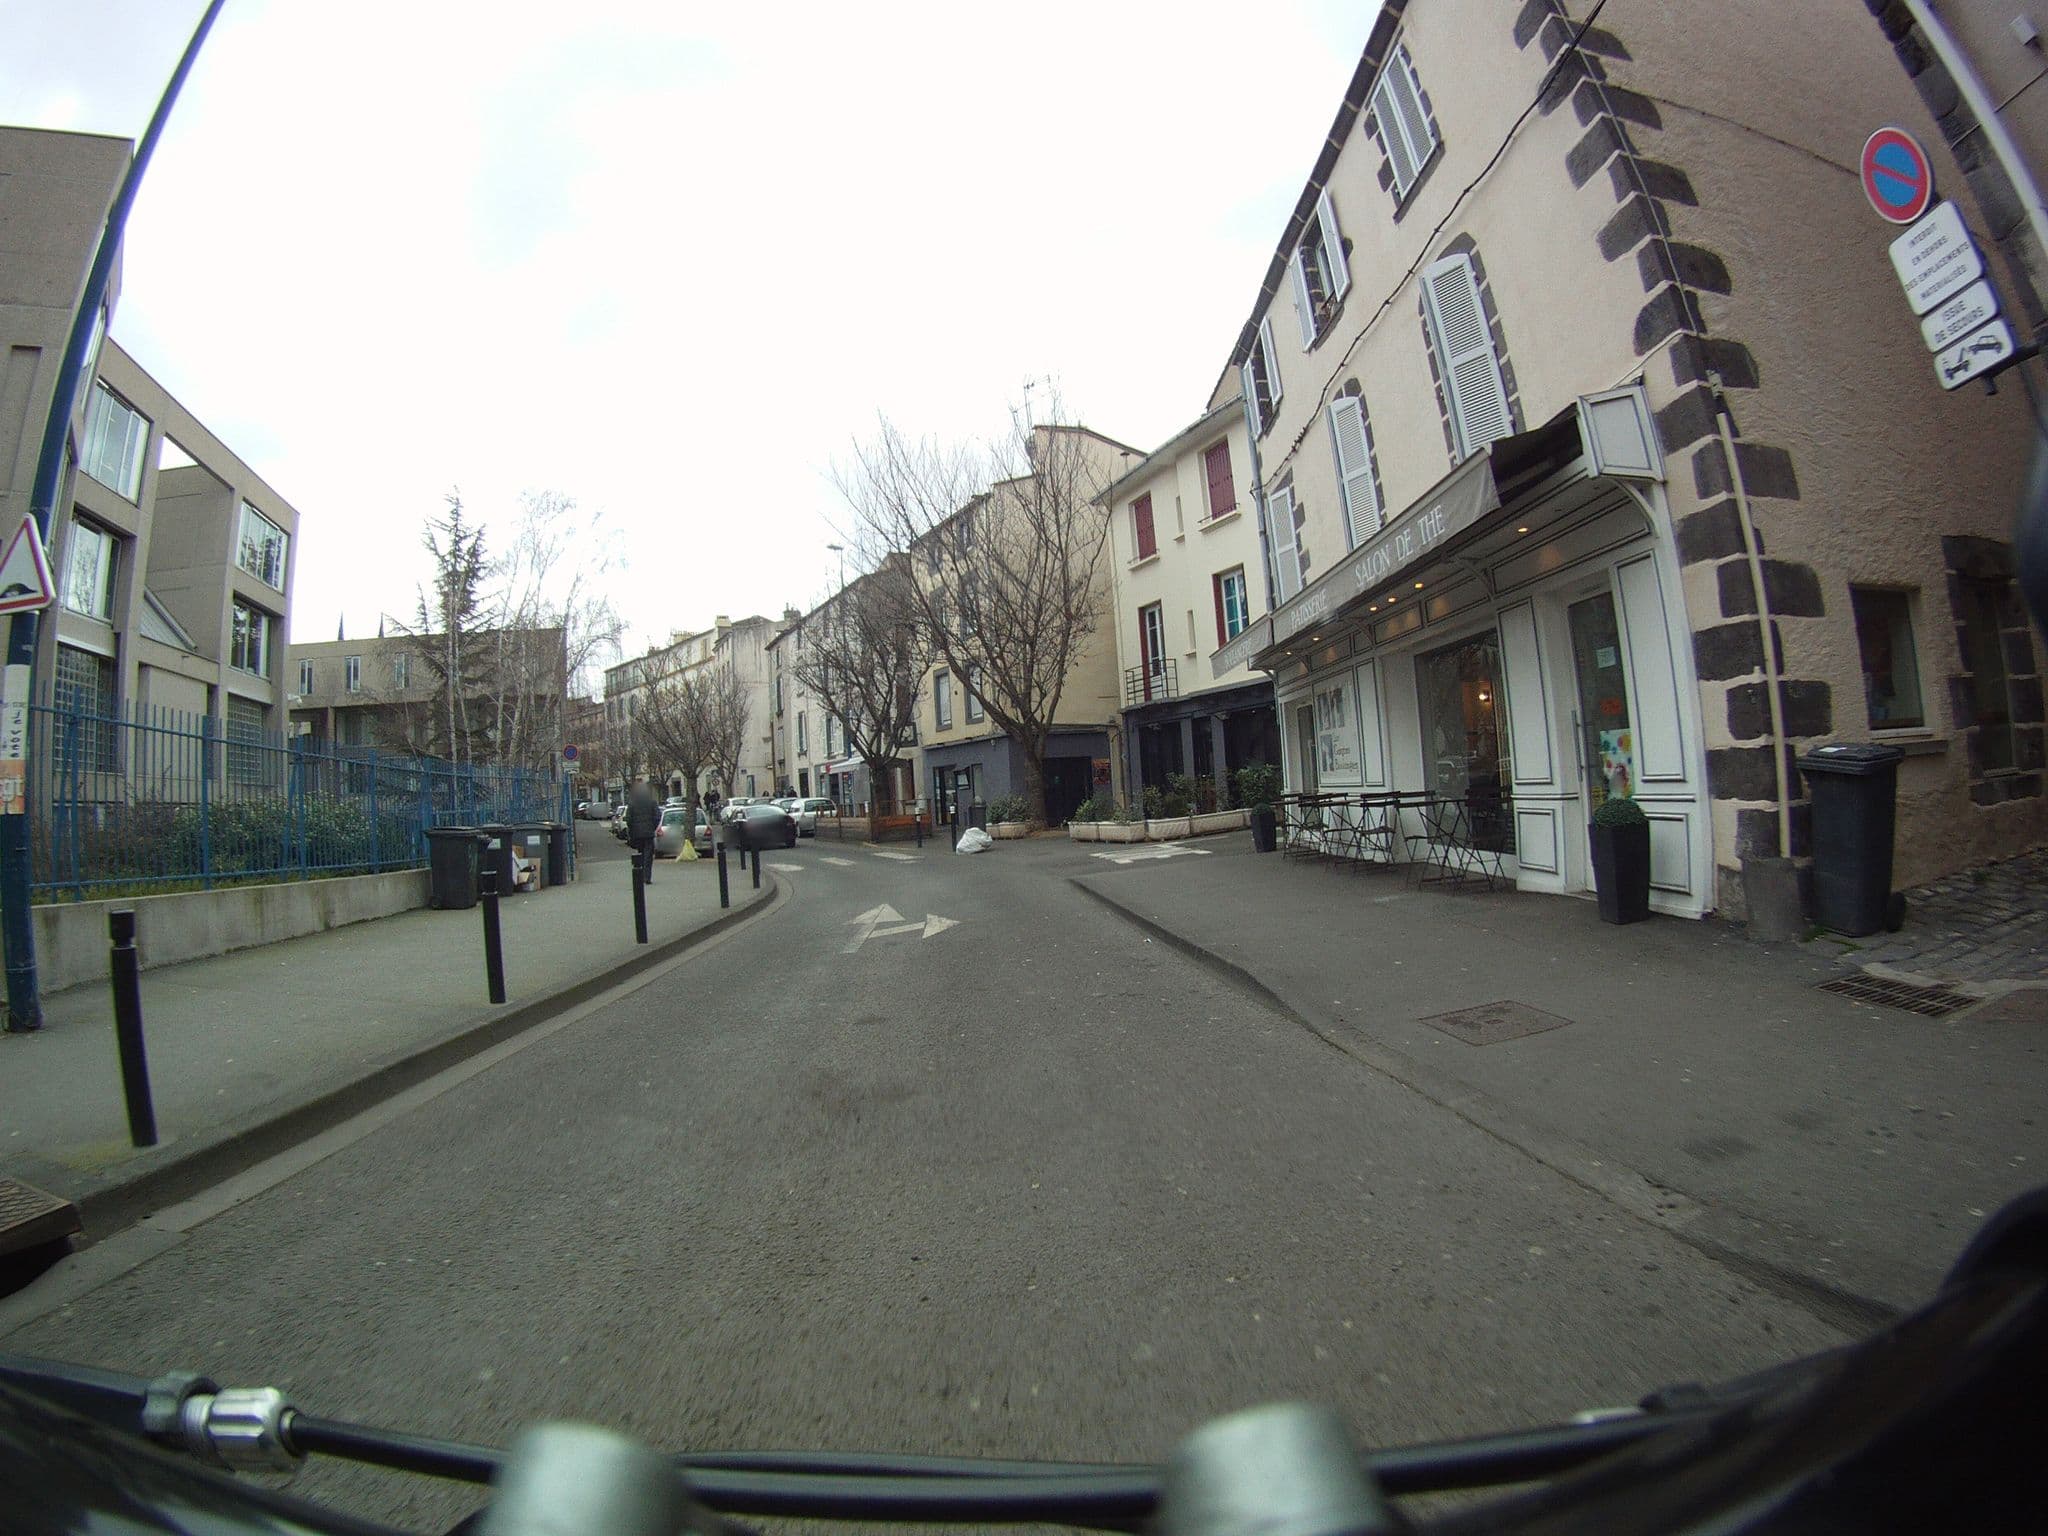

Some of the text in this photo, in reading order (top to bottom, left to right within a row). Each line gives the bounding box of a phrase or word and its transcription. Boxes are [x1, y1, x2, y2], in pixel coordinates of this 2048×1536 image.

[1905, 241, 1970, 291] DES EMPLACEMENTS
[1911, 235, 1949, 267] EN DEHORS
[1935, 306, 1985, 343] DE SECOURS
[1943, 300, 1967, 321] ISSUE
[1290, 588, 1328, 630] PATISSERIE
[1354, 543, 1391, 587] SALON
[1395, 530, 1413, 560] DE
